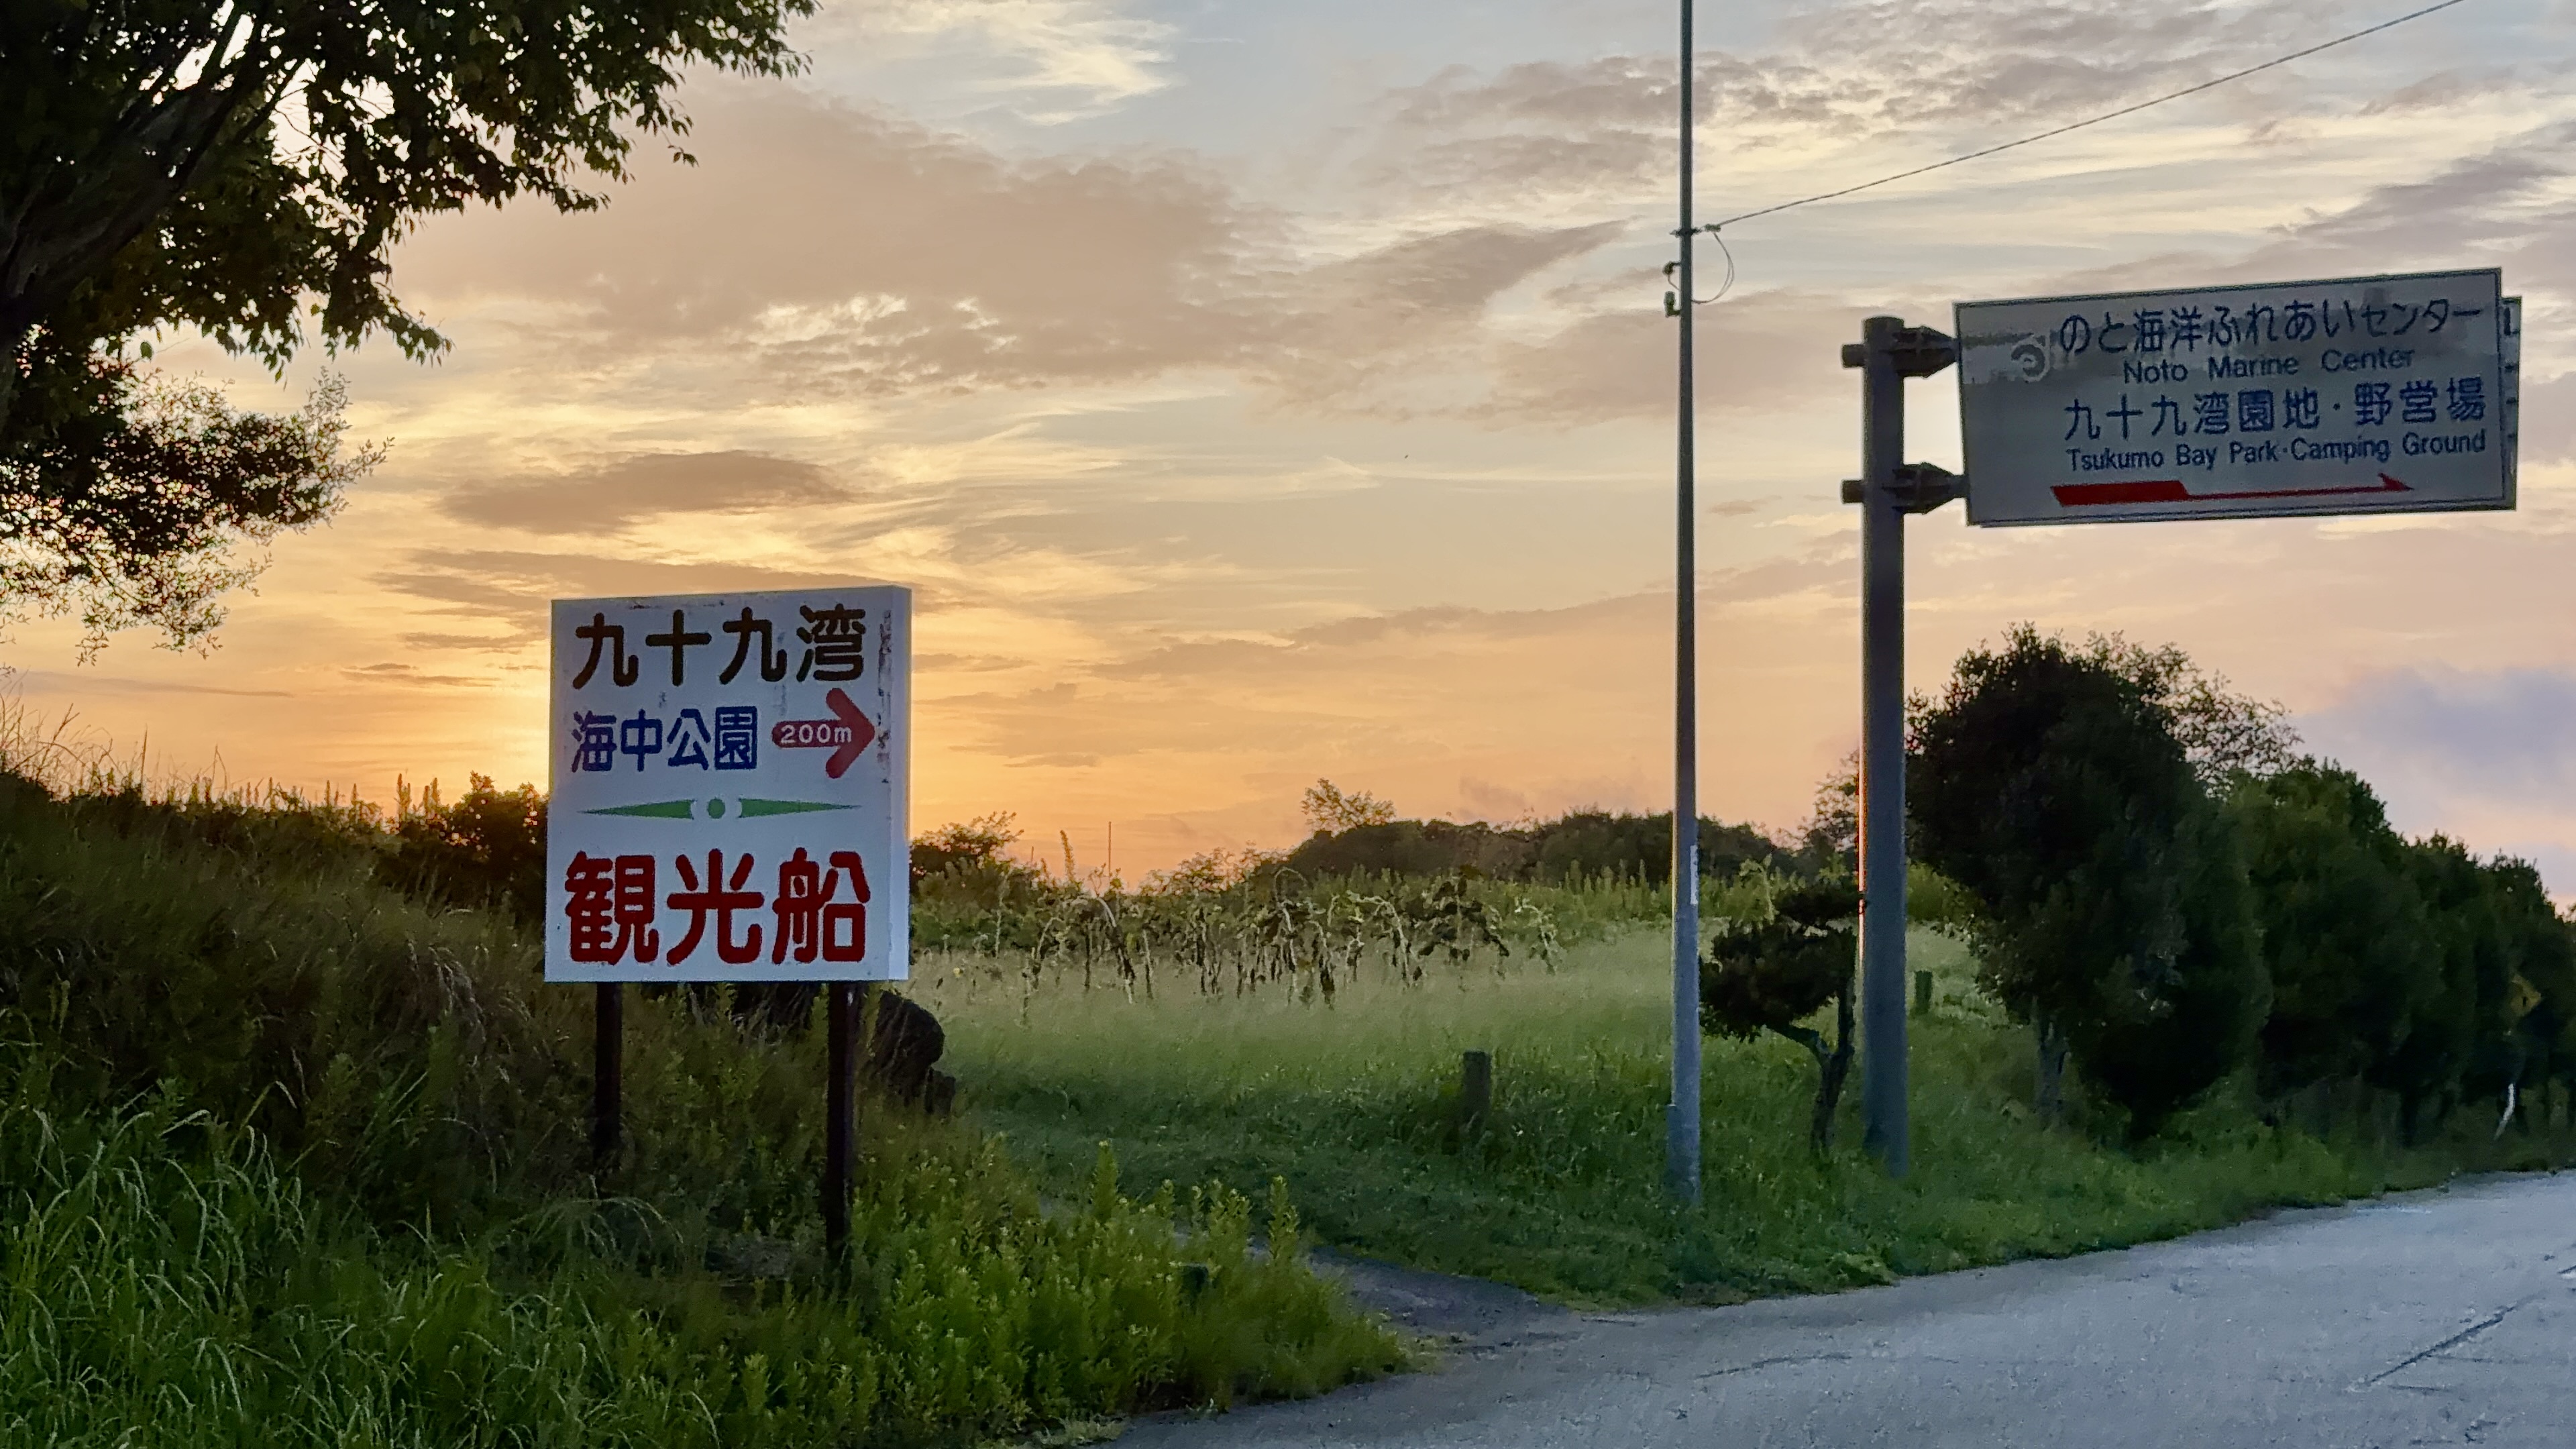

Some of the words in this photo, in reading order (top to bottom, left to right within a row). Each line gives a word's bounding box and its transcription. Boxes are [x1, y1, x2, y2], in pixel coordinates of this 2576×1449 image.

[2059, 299, 2481, 356] のと海洋ふれあいセンター
[2124, 359, 2188, 384] Noto
[2208, 356, 2299, 381] Marine
[2321, 347, 2415, 372] Center
[2065, 447, 2164, 471] Tsukumo
[2176, 443, 2217, 470] Bay
[2402, 429, 2486, 455] Ground
[573, 604, 866, 690] 九十九湾
[571, 706, 758, 773] 海中公園
[780, 723, 852, 744] 200m
[565, 847, 871, 966] 観光船
